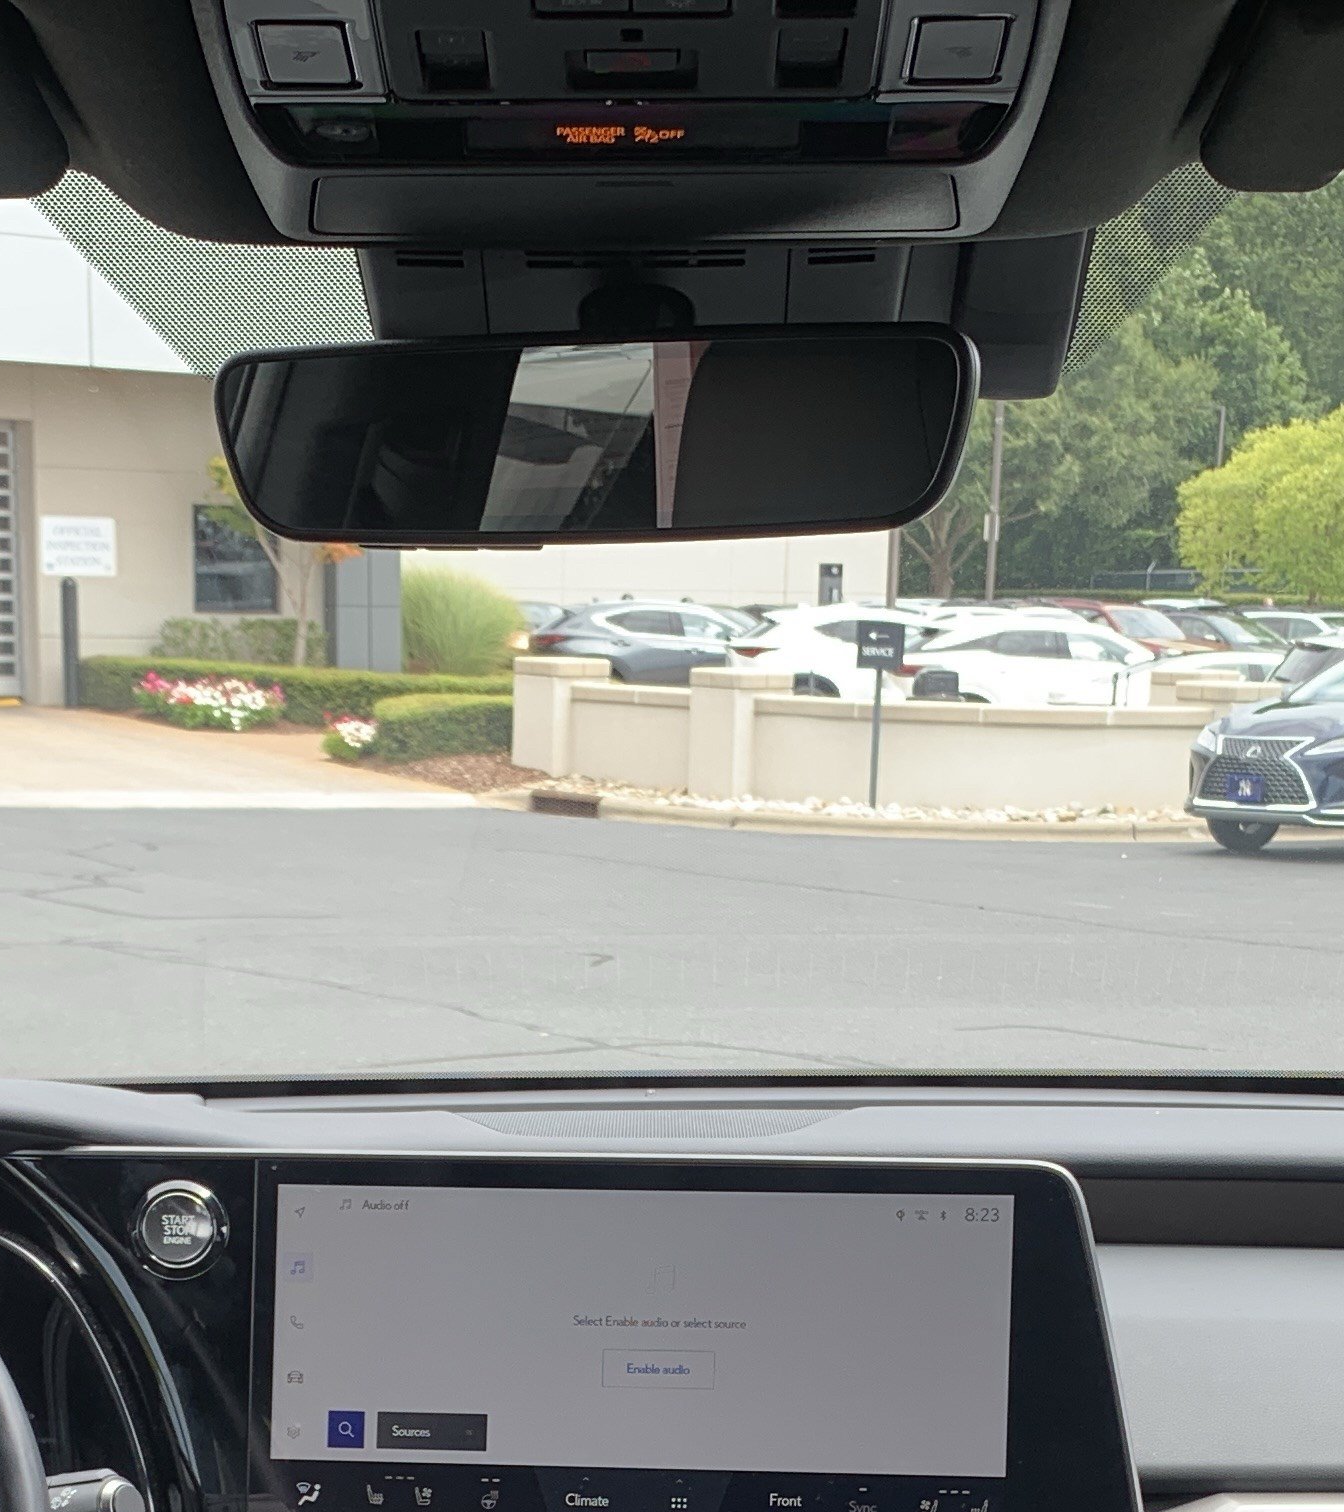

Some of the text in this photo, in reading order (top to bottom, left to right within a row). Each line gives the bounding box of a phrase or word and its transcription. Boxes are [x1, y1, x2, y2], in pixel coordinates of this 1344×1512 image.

[556, 127, 626, 136] PASSENGER
[659, 130, 685, 139] OFF
[566, 135, 616, 143] AIR BAG
[45, 540, 112, 552] INSPECTION
[861, 646, 894, 657] SERVICE
[361, 1199, 411, 1211] Audio off
[161, 1214, 196, 1226] START
[964, 1207, 1000, 1222] 8:23
[163, 1236, 192, 1245] ENGINE
[573, 1314, 603, 1327] Select
[605, 1315, 639, 1328] Enable
[641, 1316, 669, 1329] audio
[683, 1317, 712, 1329] select
[714, 1320, 747, 1330] source
[626, 1362, 691, 1375] Enable audio
[391, 1425, 431, 1438] Sources
[565, 1493, 610, 1508] Climate
[769, 1493, 803, 1508] Front
